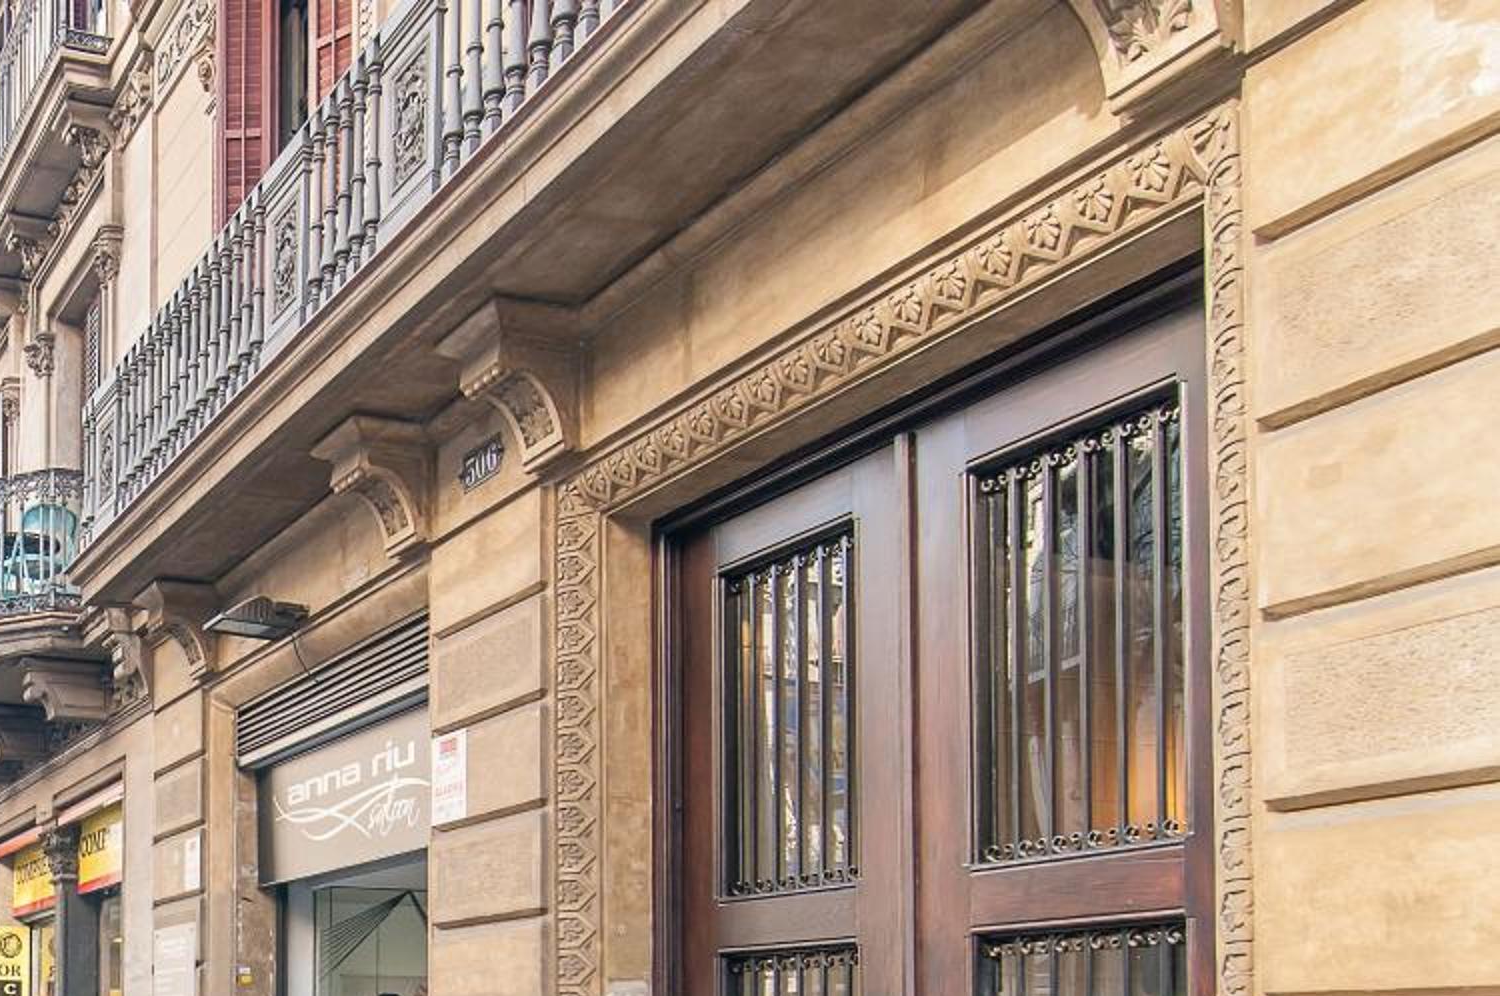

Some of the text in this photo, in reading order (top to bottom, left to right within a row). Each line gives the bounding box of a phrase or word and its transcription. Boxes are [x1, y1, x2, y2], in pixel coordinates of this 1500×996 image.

[465, 443, 498, 486] 506
[287, 740, 415, 806] anna riu
